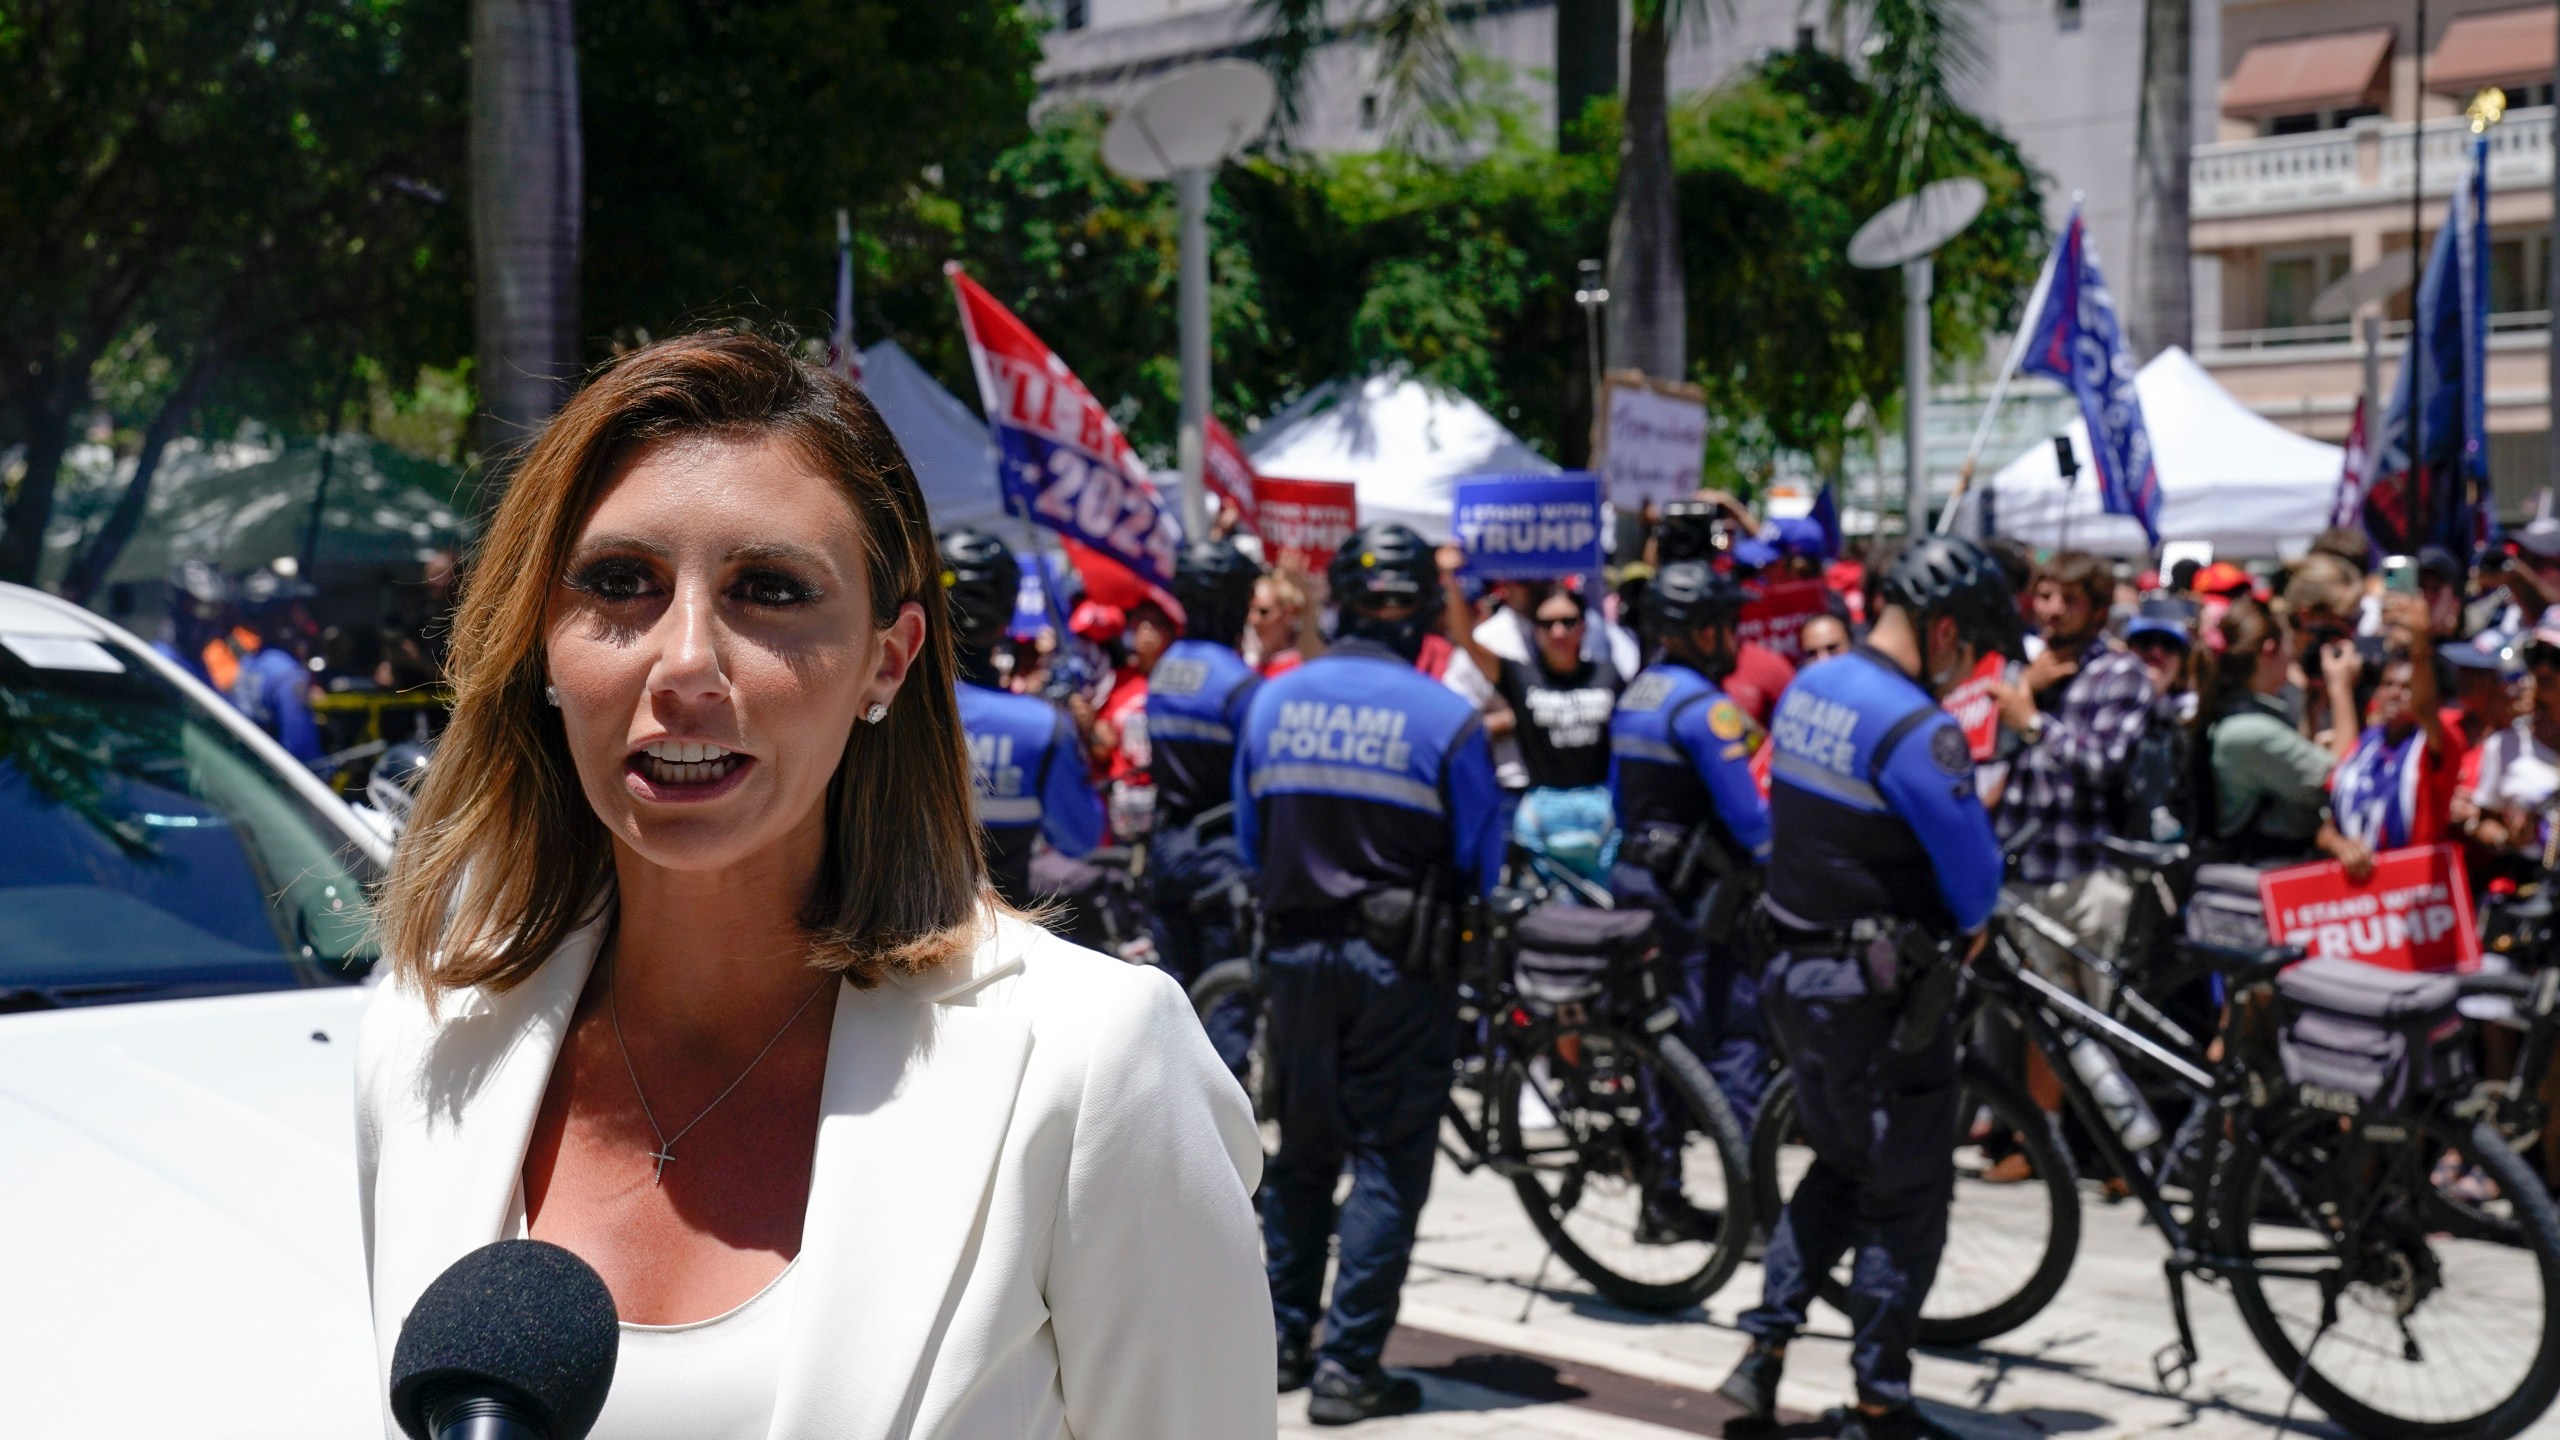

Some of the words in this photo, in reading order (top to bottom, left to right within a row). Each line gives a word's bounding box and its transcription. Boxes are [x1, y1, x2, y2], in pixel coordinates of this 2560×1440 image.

[1473, 503, 1538, 522] STAND
[1539, 502, 1594, 520] WITH
[1457, 521, 1595, 554] TRUMP
[1279, 700, 1407, 738] MIAMI
[1782, 690, 1859, 742] MIAMI
[1268, 728, 1412, 773] POLICE
[1771, 715, 1856, 777] POLICE
[2297, 893, 2380, 925] STAND
[2380, 881, 2449, 912] WITH
[2284, 904, 2456, 960] TRUMP
